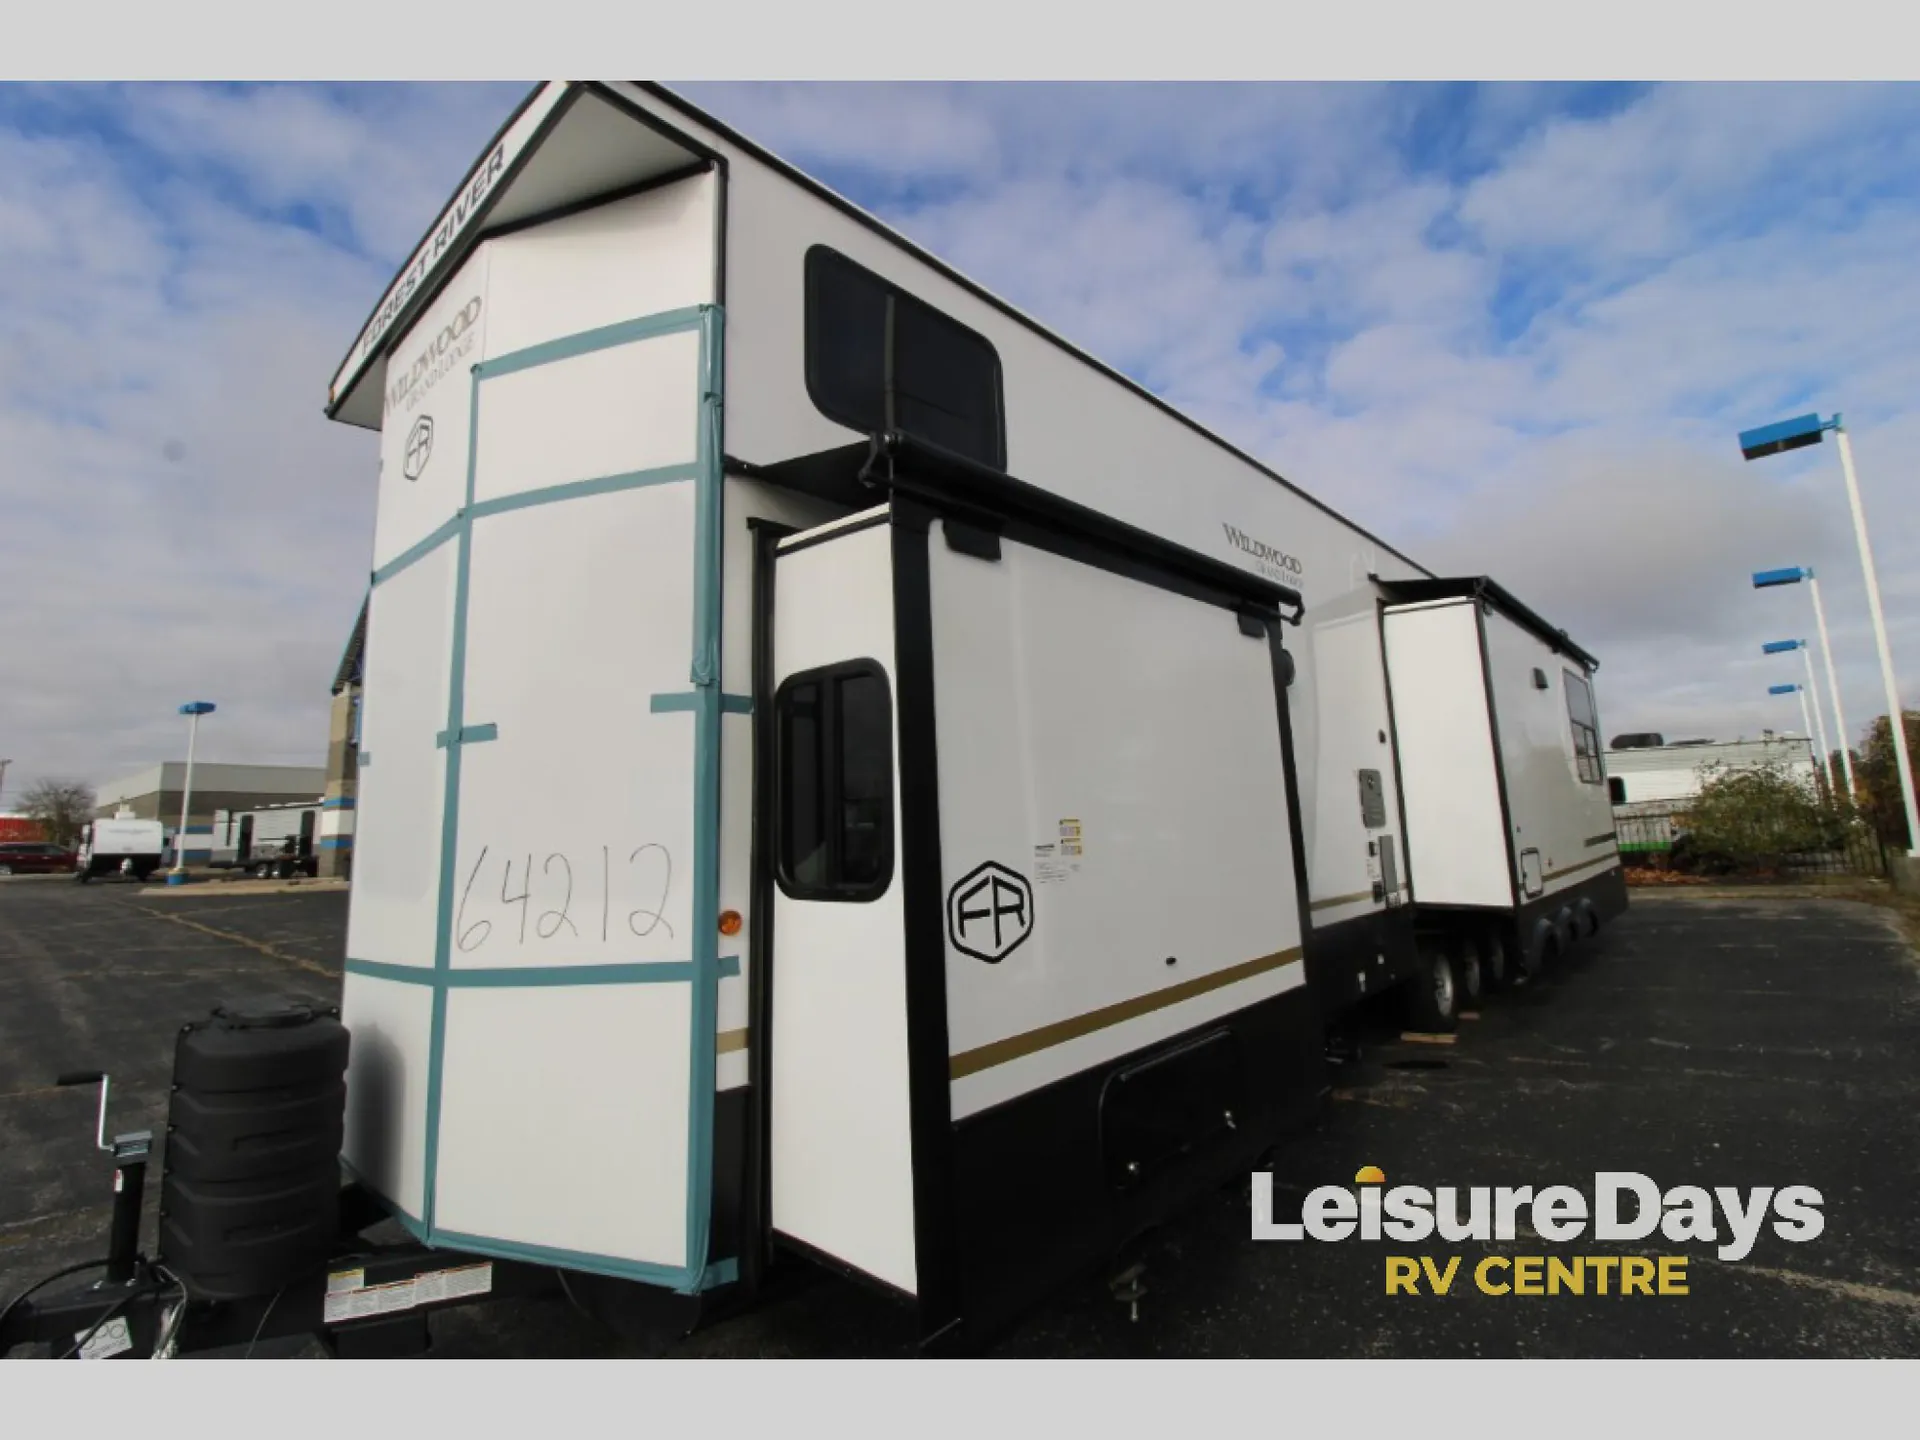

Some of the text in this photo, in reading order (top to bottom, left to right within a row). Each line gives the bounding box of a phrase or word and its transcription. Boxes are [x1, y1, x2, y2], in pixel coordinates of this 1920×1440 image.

[361, 144, 504, 356] FOREST RIVER
[384, 295, 482, 416] WILDWOOD
[1222, 521, 1302, 575] WILDWOOD
[457, 843, 674, 953] 64212
[957, 874, 1026, 949] FR
